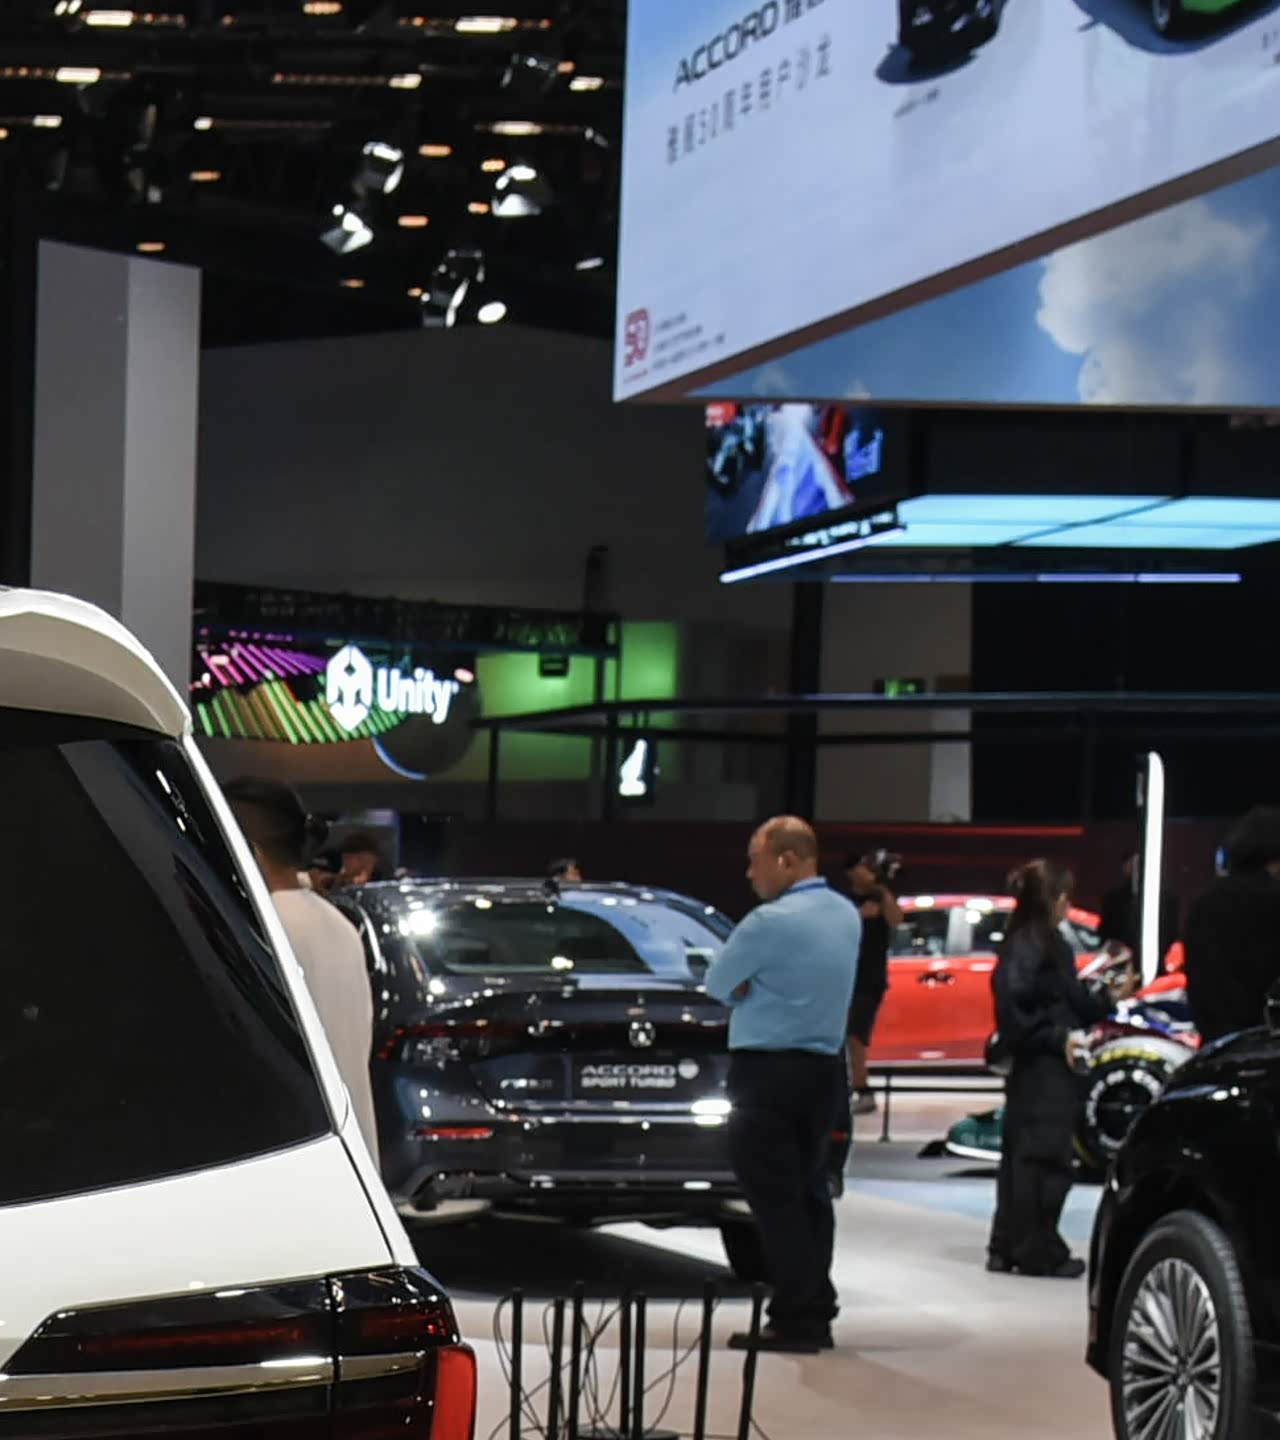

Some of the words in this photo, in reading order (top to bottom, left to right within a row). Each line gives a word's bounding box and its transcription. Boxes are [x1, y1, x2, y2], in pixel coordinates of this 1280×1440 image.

[672, 0, 779, 93] ACCORD
[377, 667, 453, 724] Unity
[581, 1064, 676, 1075] ACCORD
